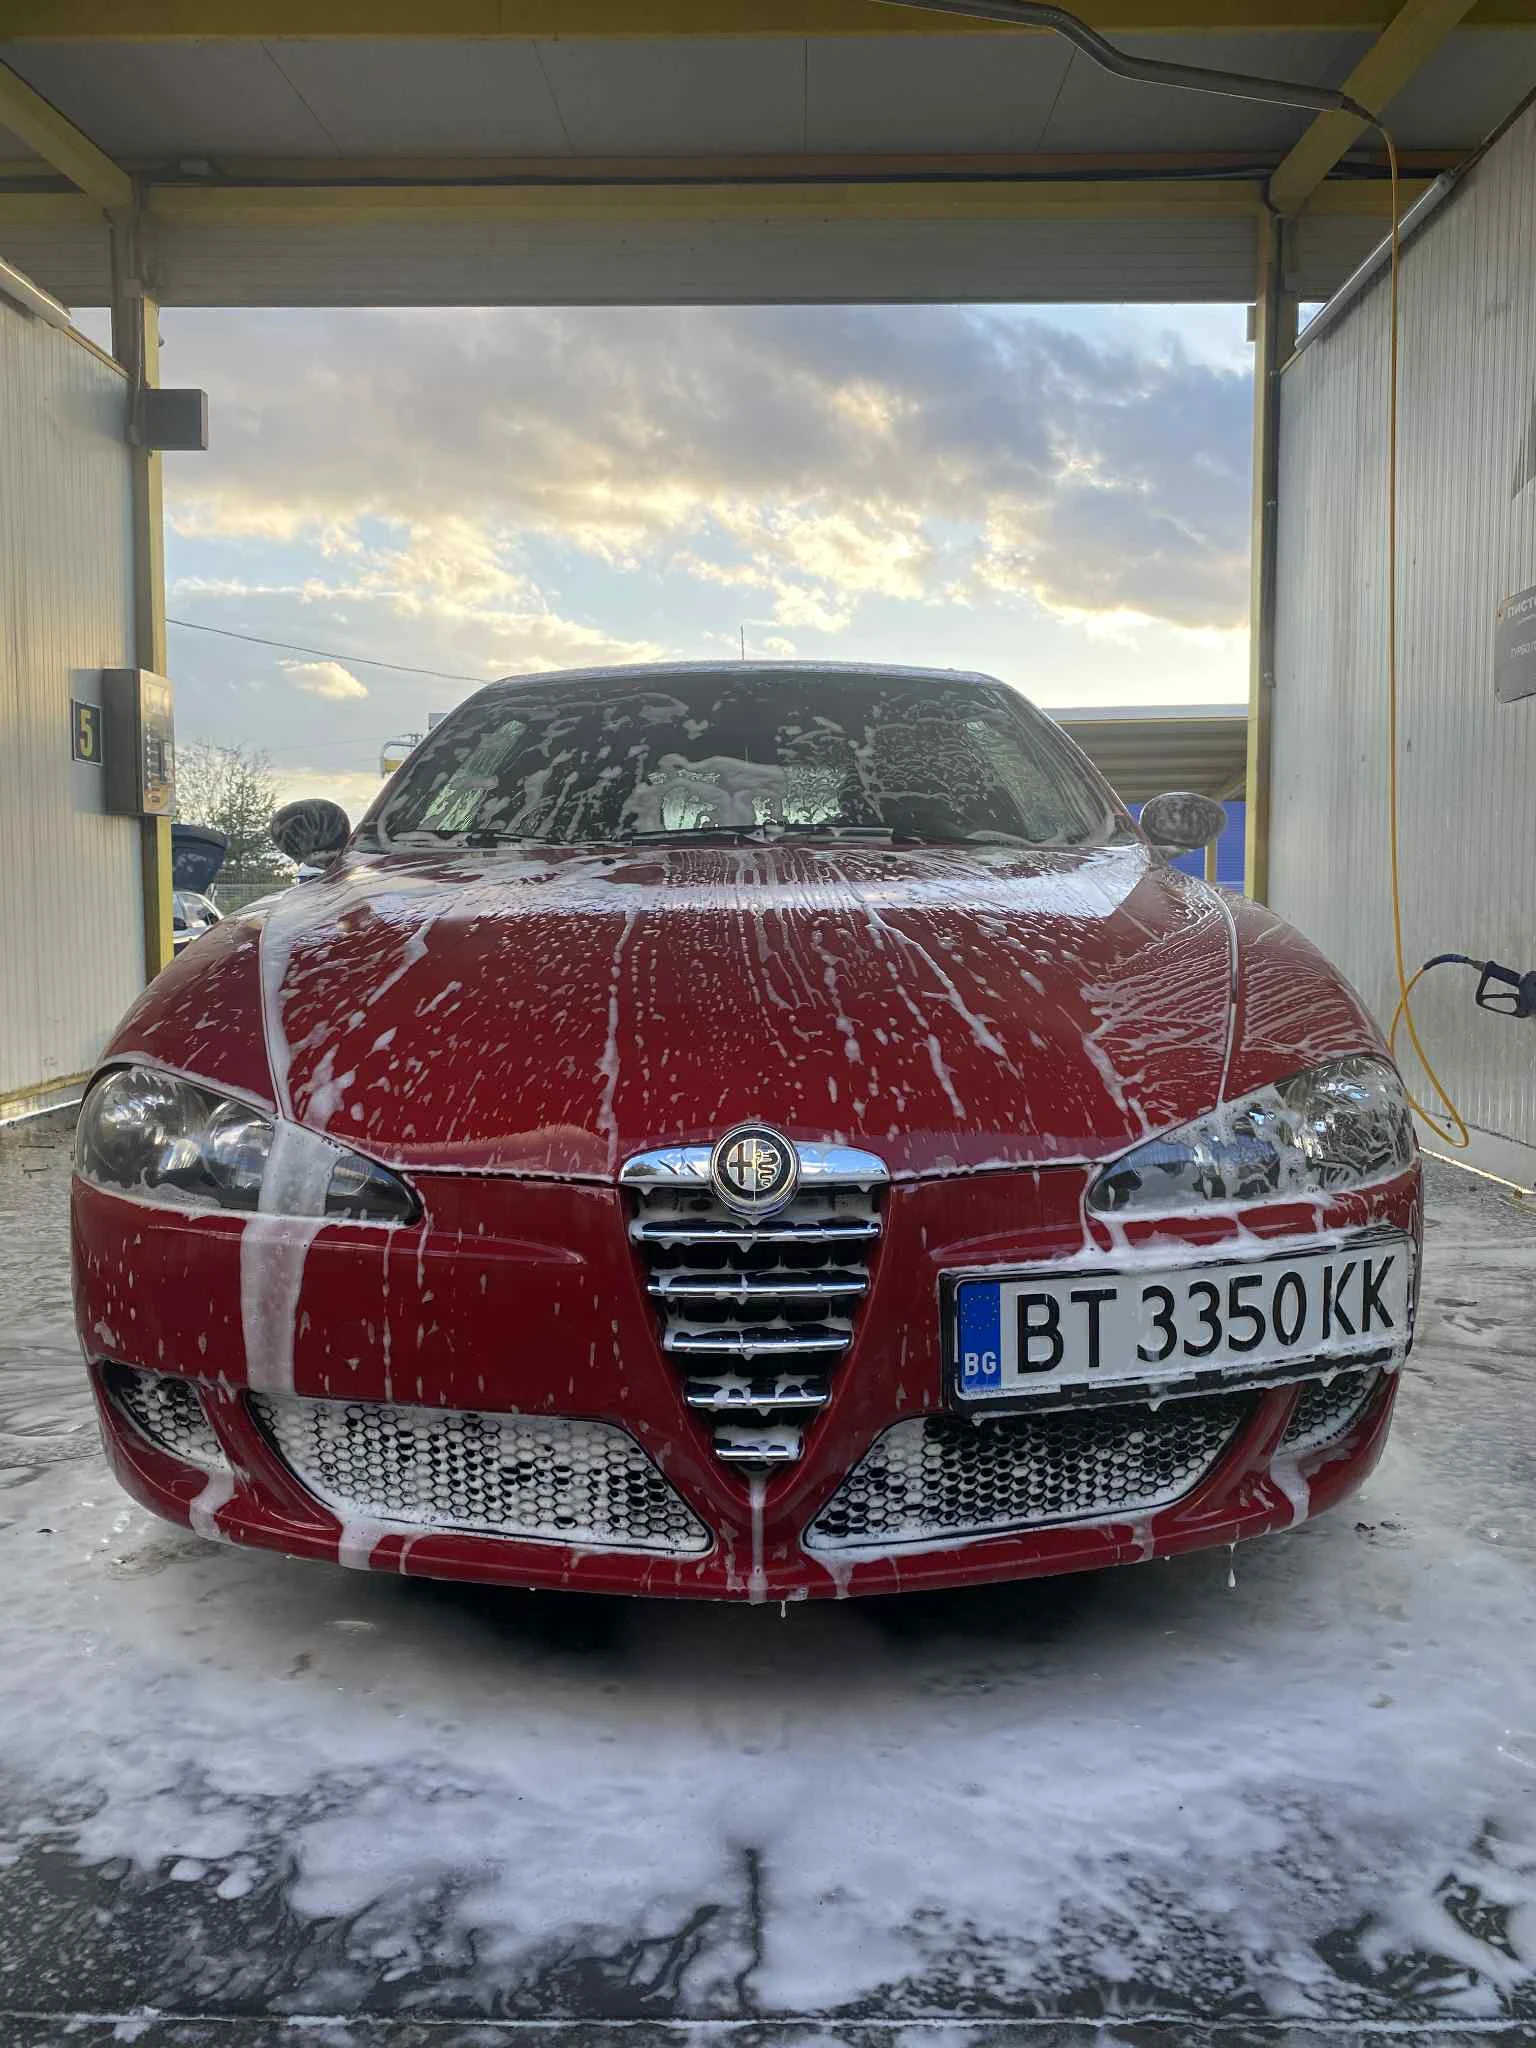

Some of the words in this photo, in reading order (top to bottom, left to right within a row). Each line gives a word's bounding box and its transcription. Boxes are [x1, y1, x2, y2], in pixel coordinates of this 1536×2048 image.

[80, 709, 93, 758] 5
[1016, 1288, 1118, 1375] BT
[1136, 1271, 1308, 1362] 3350
[1321, 1255, 1396, 1340] KK
[963, 1351, 998, 1377] BG
